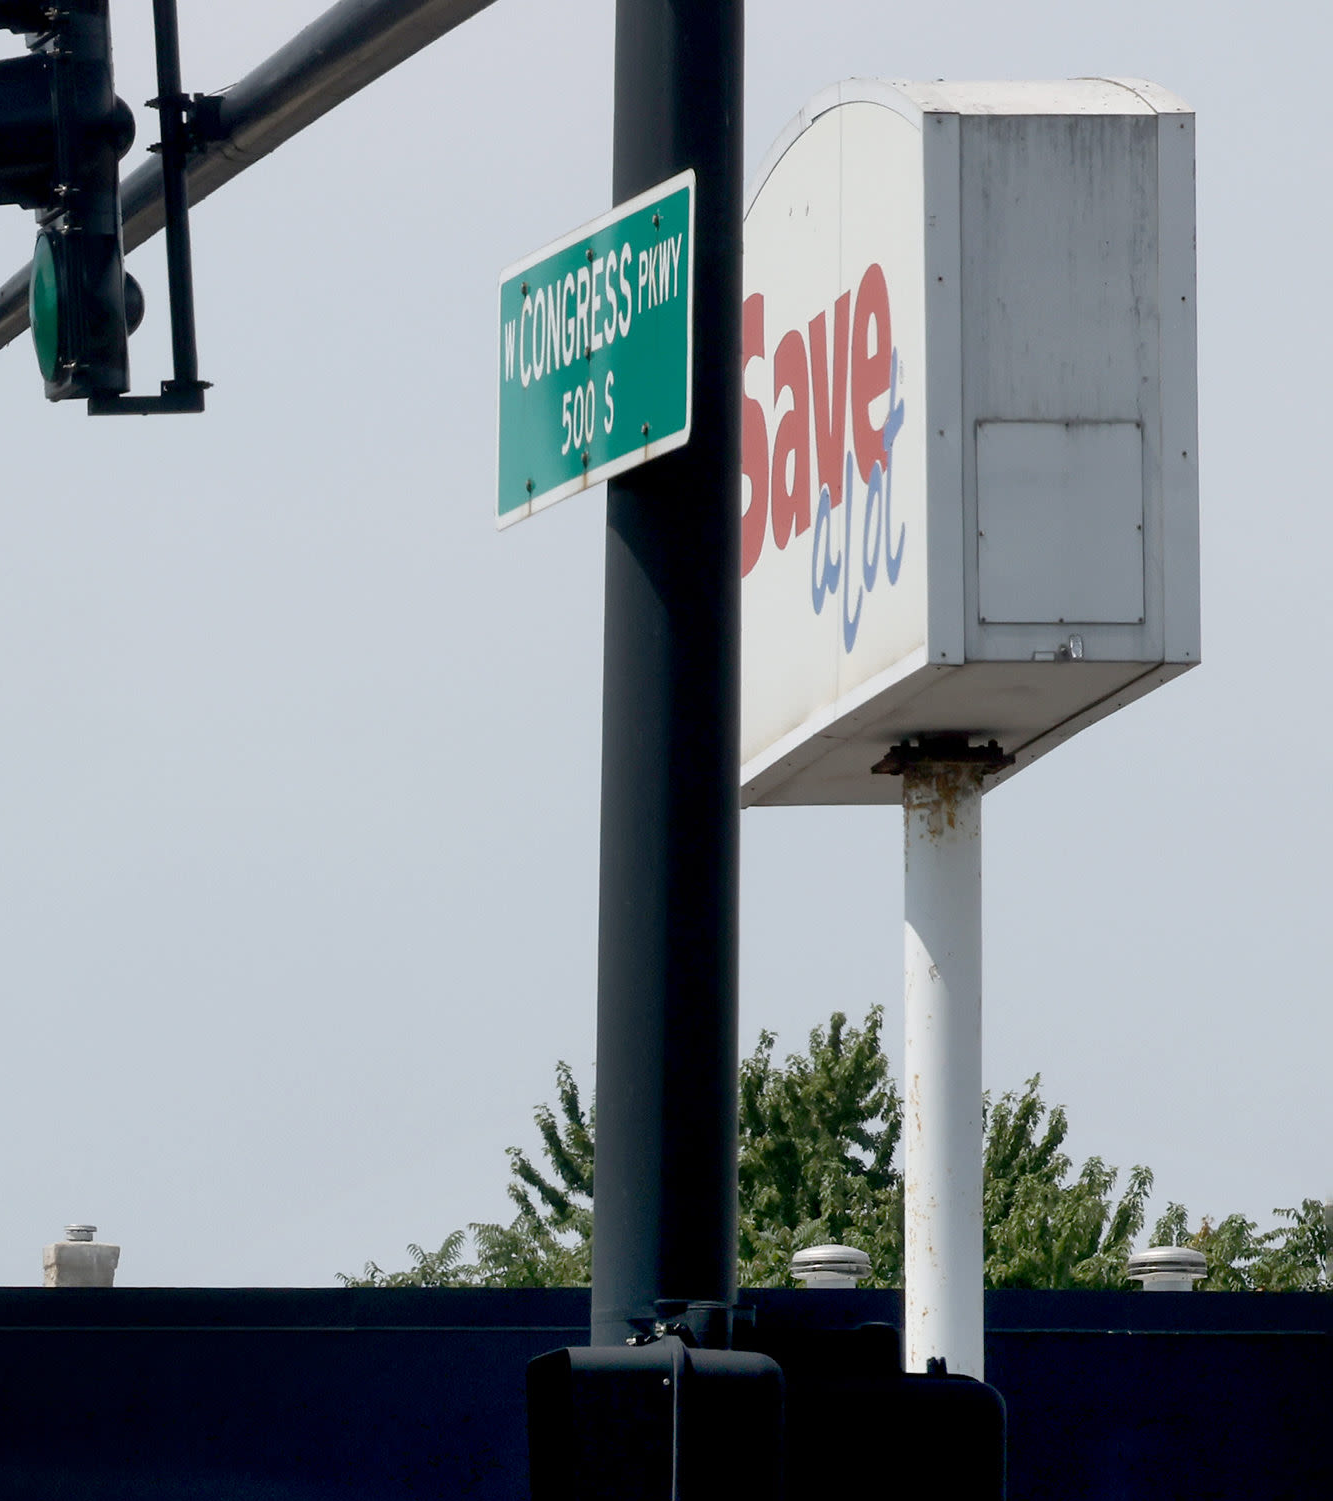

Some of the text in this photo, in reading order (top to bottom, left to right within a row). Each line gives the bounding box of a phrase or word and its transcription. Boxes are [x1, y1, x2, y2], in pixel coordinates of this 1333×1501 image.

[504, 233, 683, 388] W CONGRESS PKWY
[561, 370, 614, 456] 500 S
